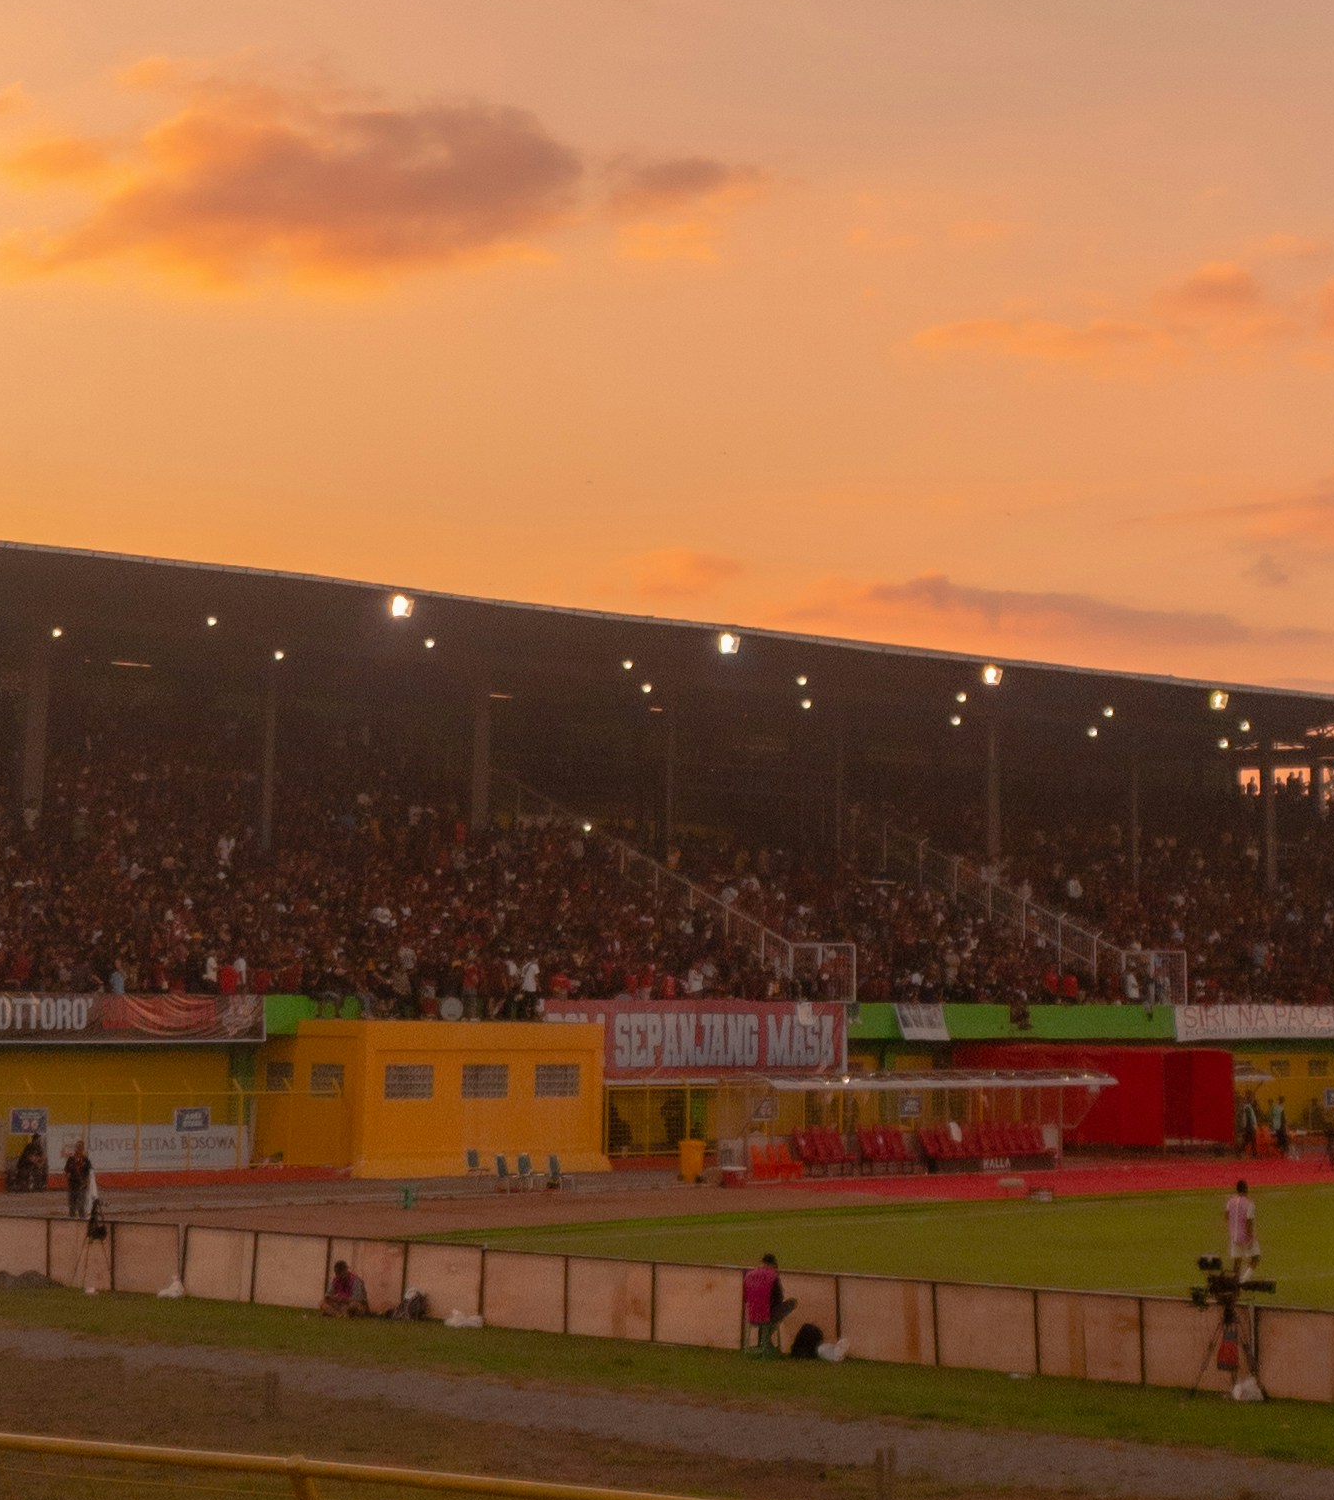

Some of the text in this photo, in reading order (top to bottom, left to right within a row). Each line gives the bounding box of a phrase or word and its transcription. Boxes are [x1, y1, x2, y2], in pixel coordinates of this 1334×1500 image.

[1238, 1006, 1269, 1026] NA
[613, 1012, 835, 1068] SEPANJANG MASA
[88, 1135, 237, 1152] UNIVERSITAS BOSOWA
